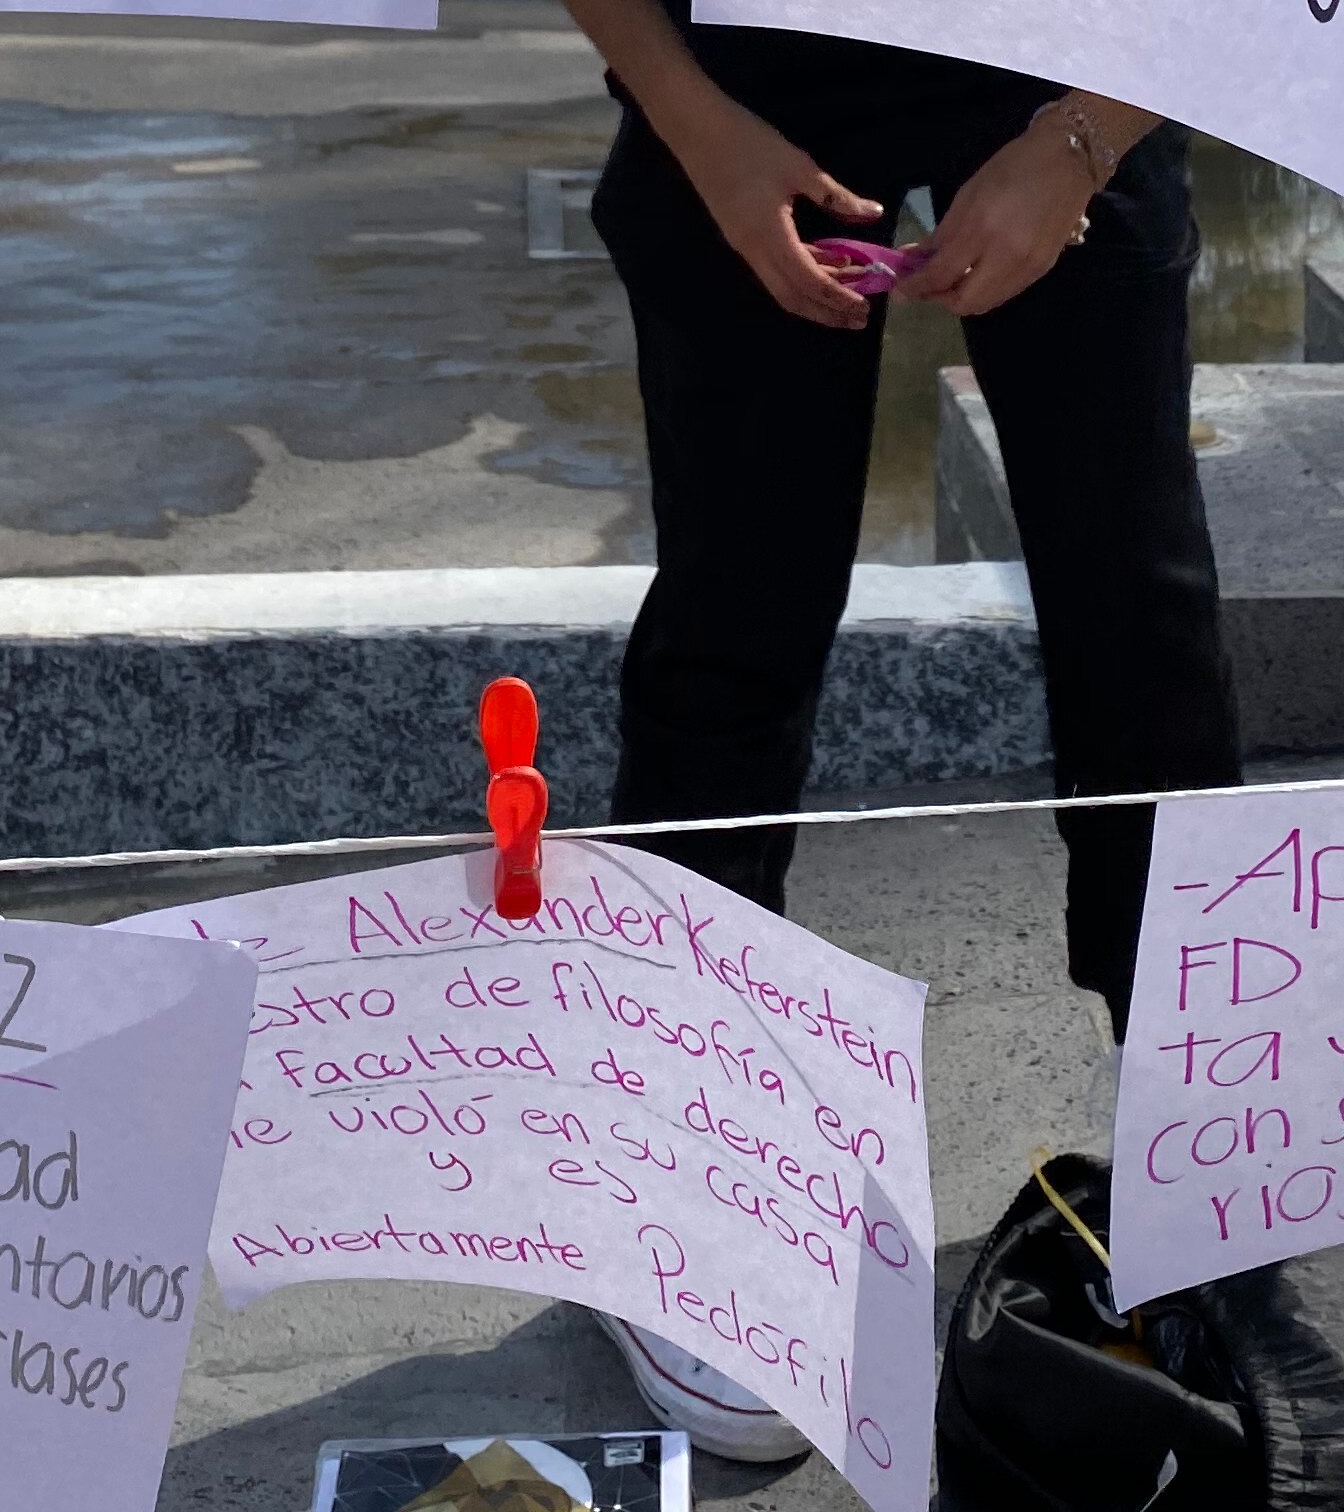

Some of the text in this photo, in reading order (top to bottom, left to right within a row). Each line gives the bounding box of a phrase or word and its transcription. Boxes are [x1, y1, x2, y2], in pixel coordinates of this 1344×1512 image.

[1177, 936, 1303, 1012] FD
[249, 961, 886, 1166] stro de filosofía en
[1157, 1031, 1282, 1087] ta
[274, 1033, 910, 1269] Facultad de derecho
[328, 1089, 495, 1138] violó
[520, 1107, 591, 1145] en
[609, 1120, 677, 1172] su
[705, 1164, 840, 1287] casa
[428, 1151, 638, 1204] y es
[1146, 1106, 1292, 1185] con
[232, 1212, 893, 1470] Abiertamente Pedófilo
